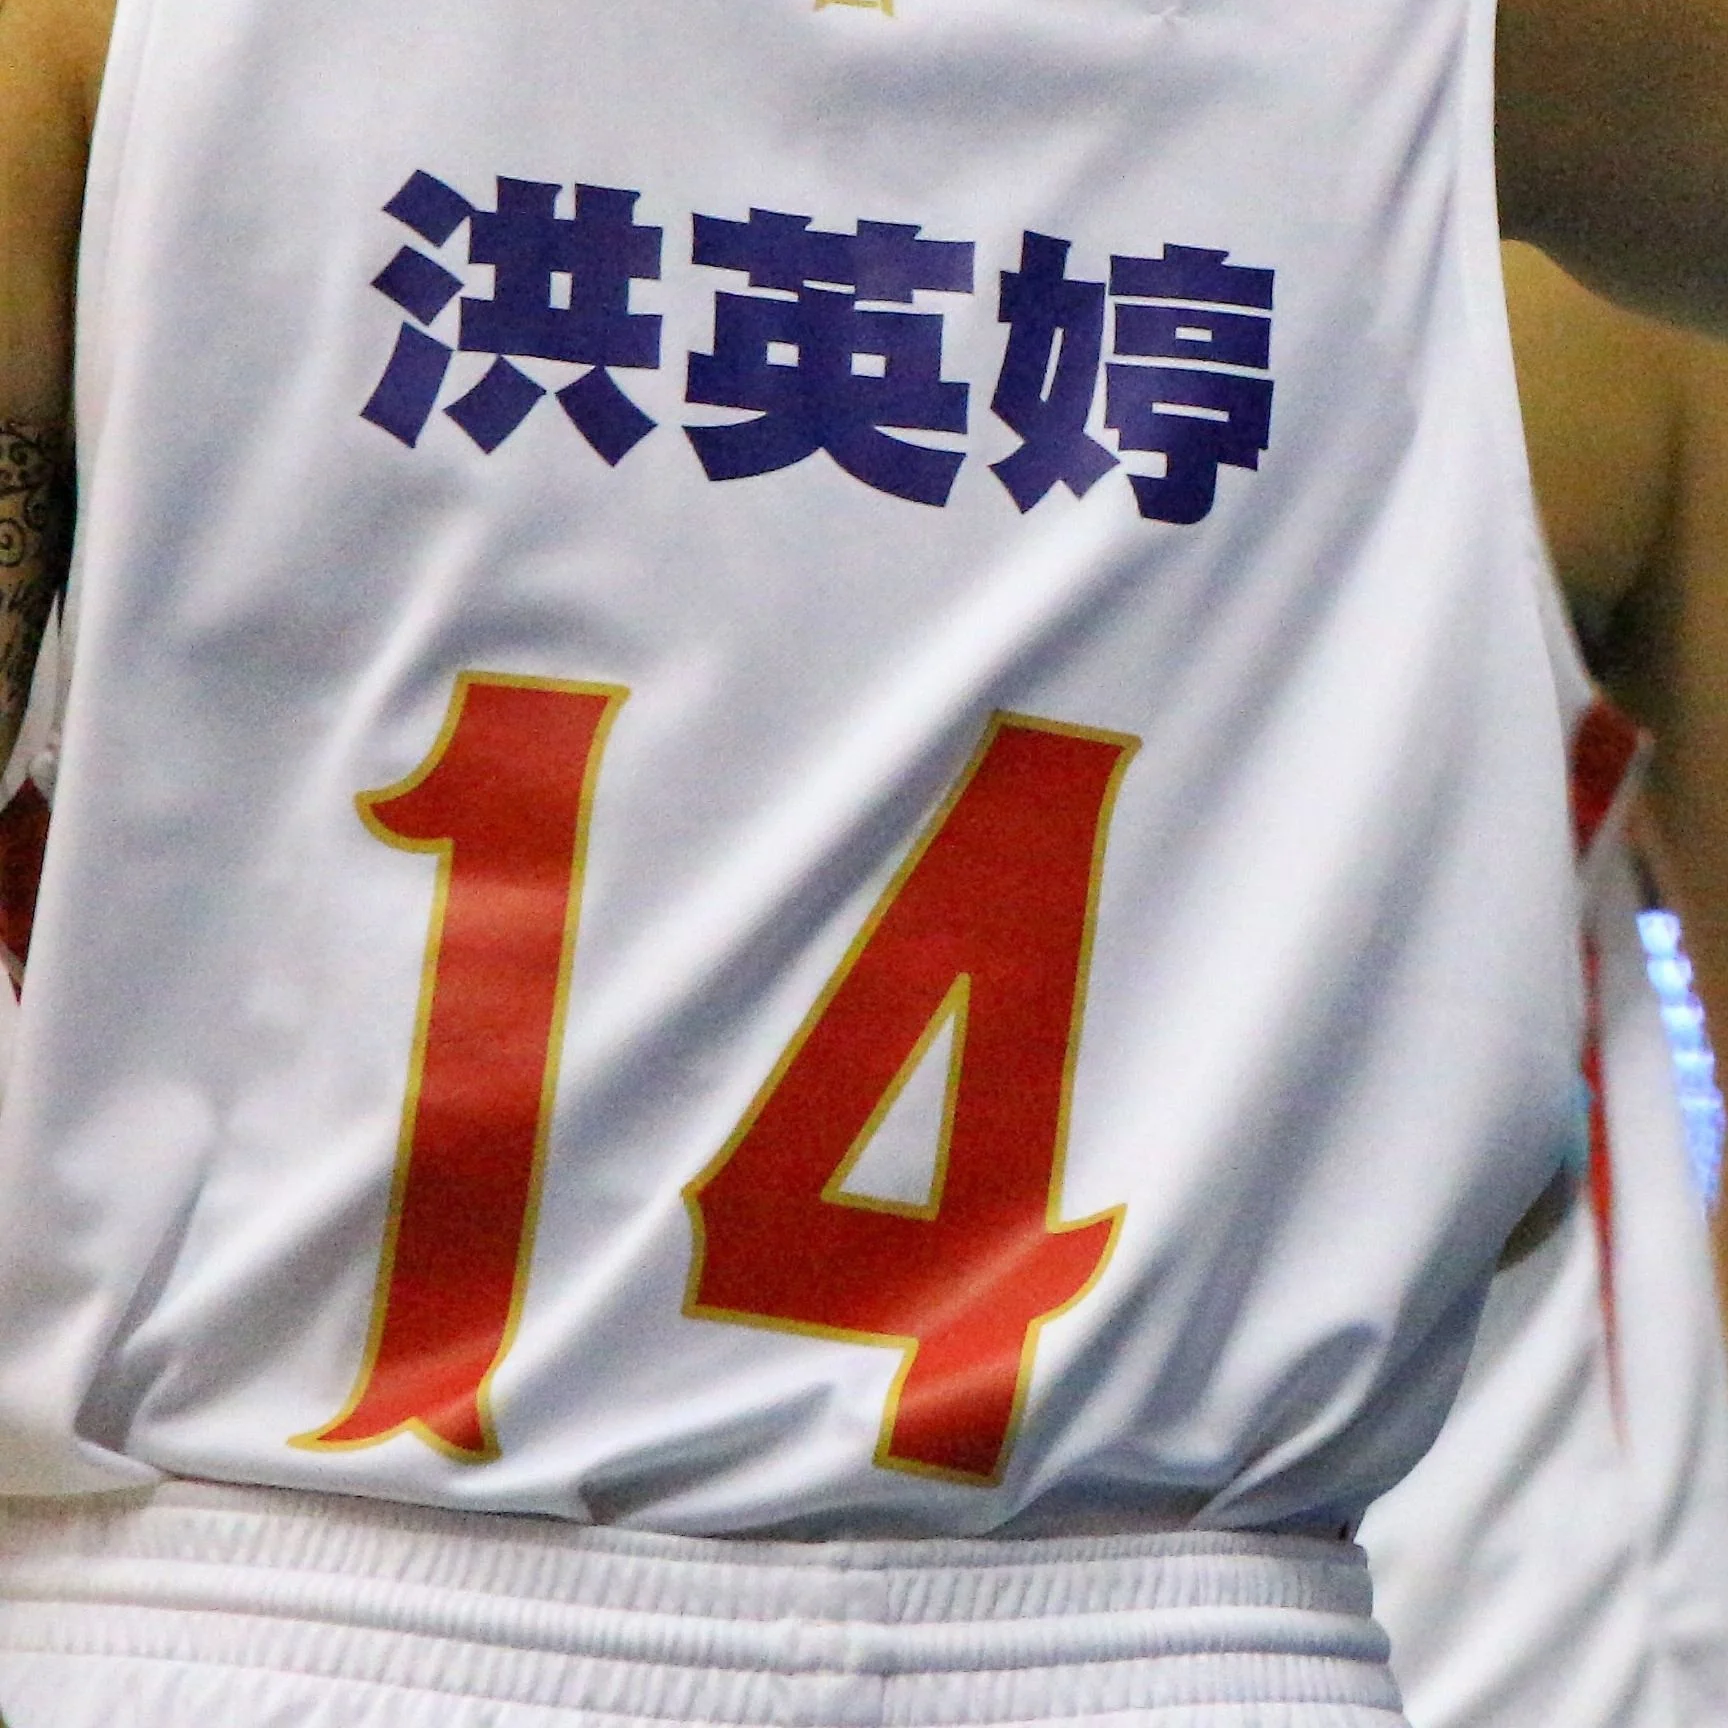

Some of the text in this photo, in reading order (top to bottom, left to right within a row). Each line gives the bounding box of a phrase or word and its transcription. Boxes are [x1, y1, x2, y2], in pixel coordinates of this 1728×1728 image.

[361, 169, 1276, 526] 洪英婷
[288, 670, 1141, 1487] 14
